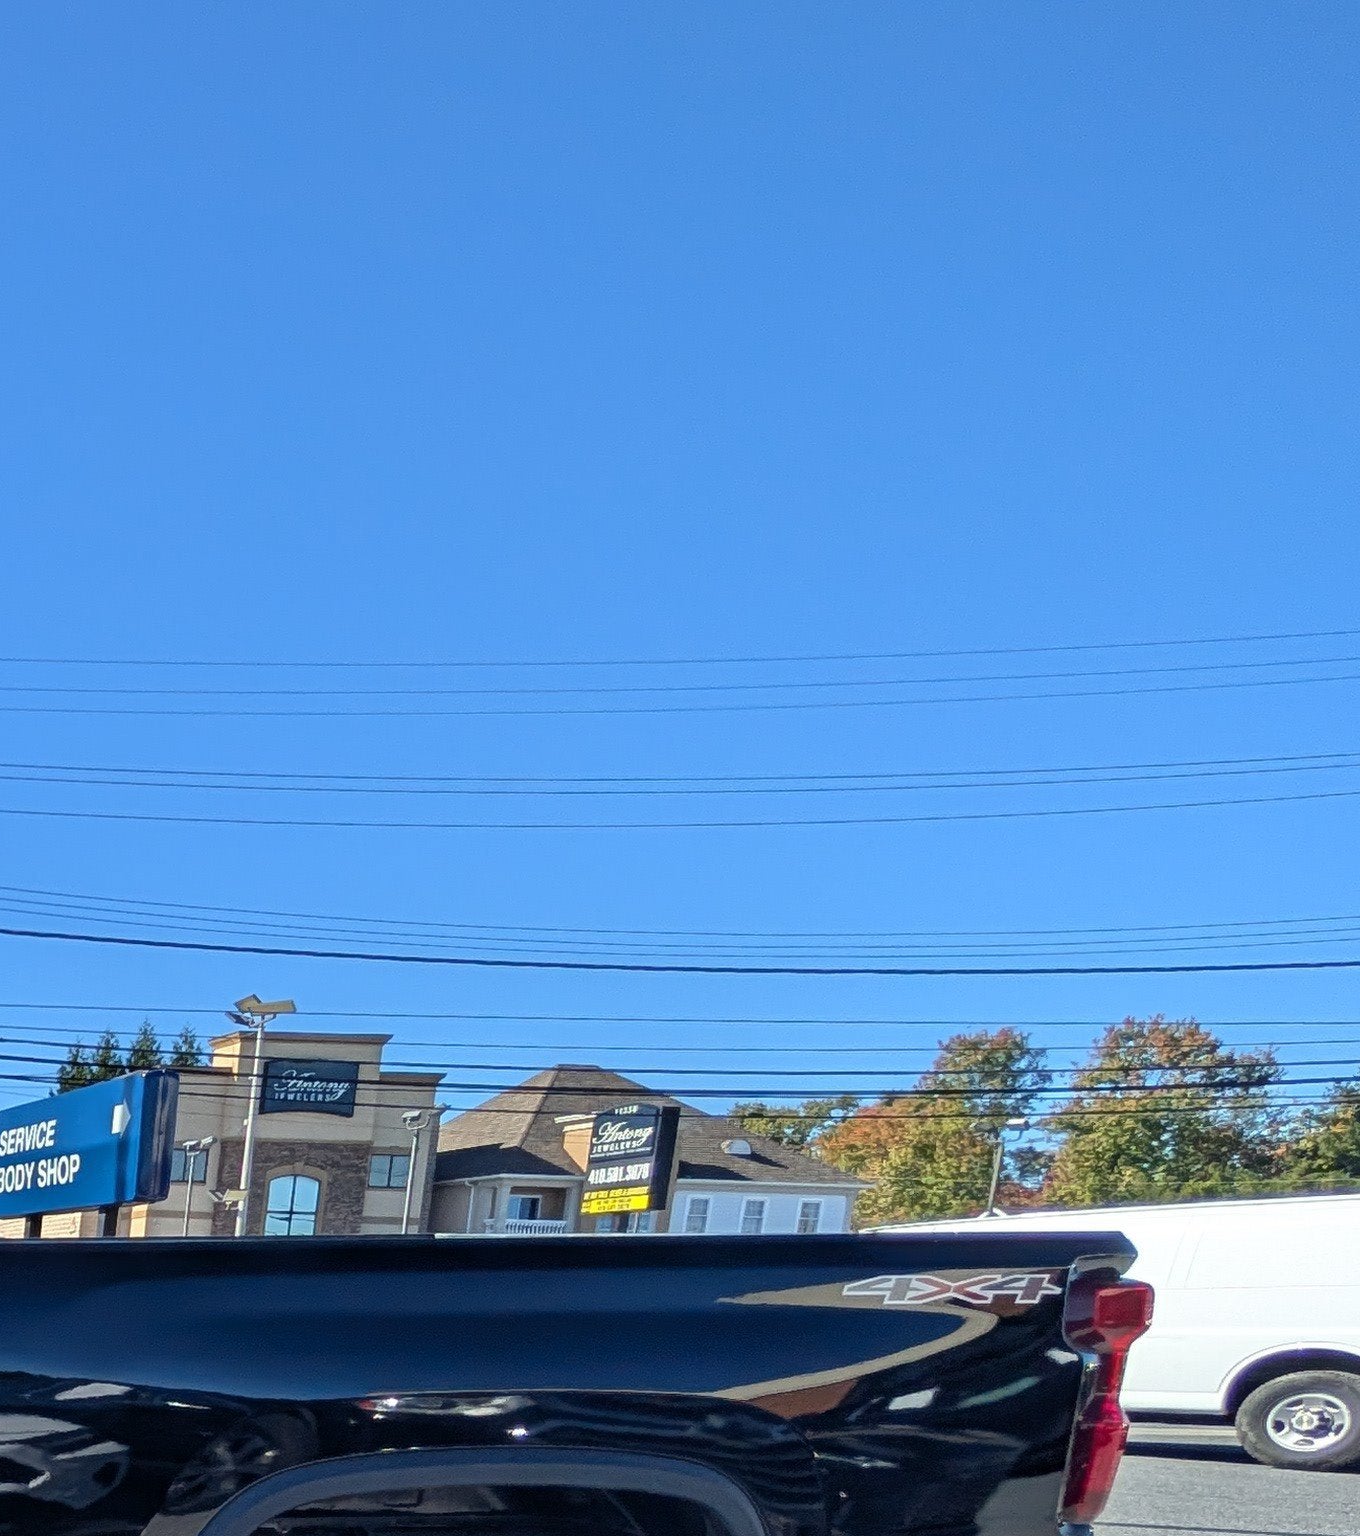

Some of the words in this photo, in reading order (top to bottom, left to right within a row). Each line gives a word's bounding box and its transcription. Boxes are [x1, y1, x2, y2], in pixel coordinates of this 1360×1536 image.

[273, 1069, 351, 1101] Antony
[592, 1121, 654, 1147] Antony
[37, 1153, 81, 1188] SHOP
[842, 1274, 1065, 1305] 4X4
